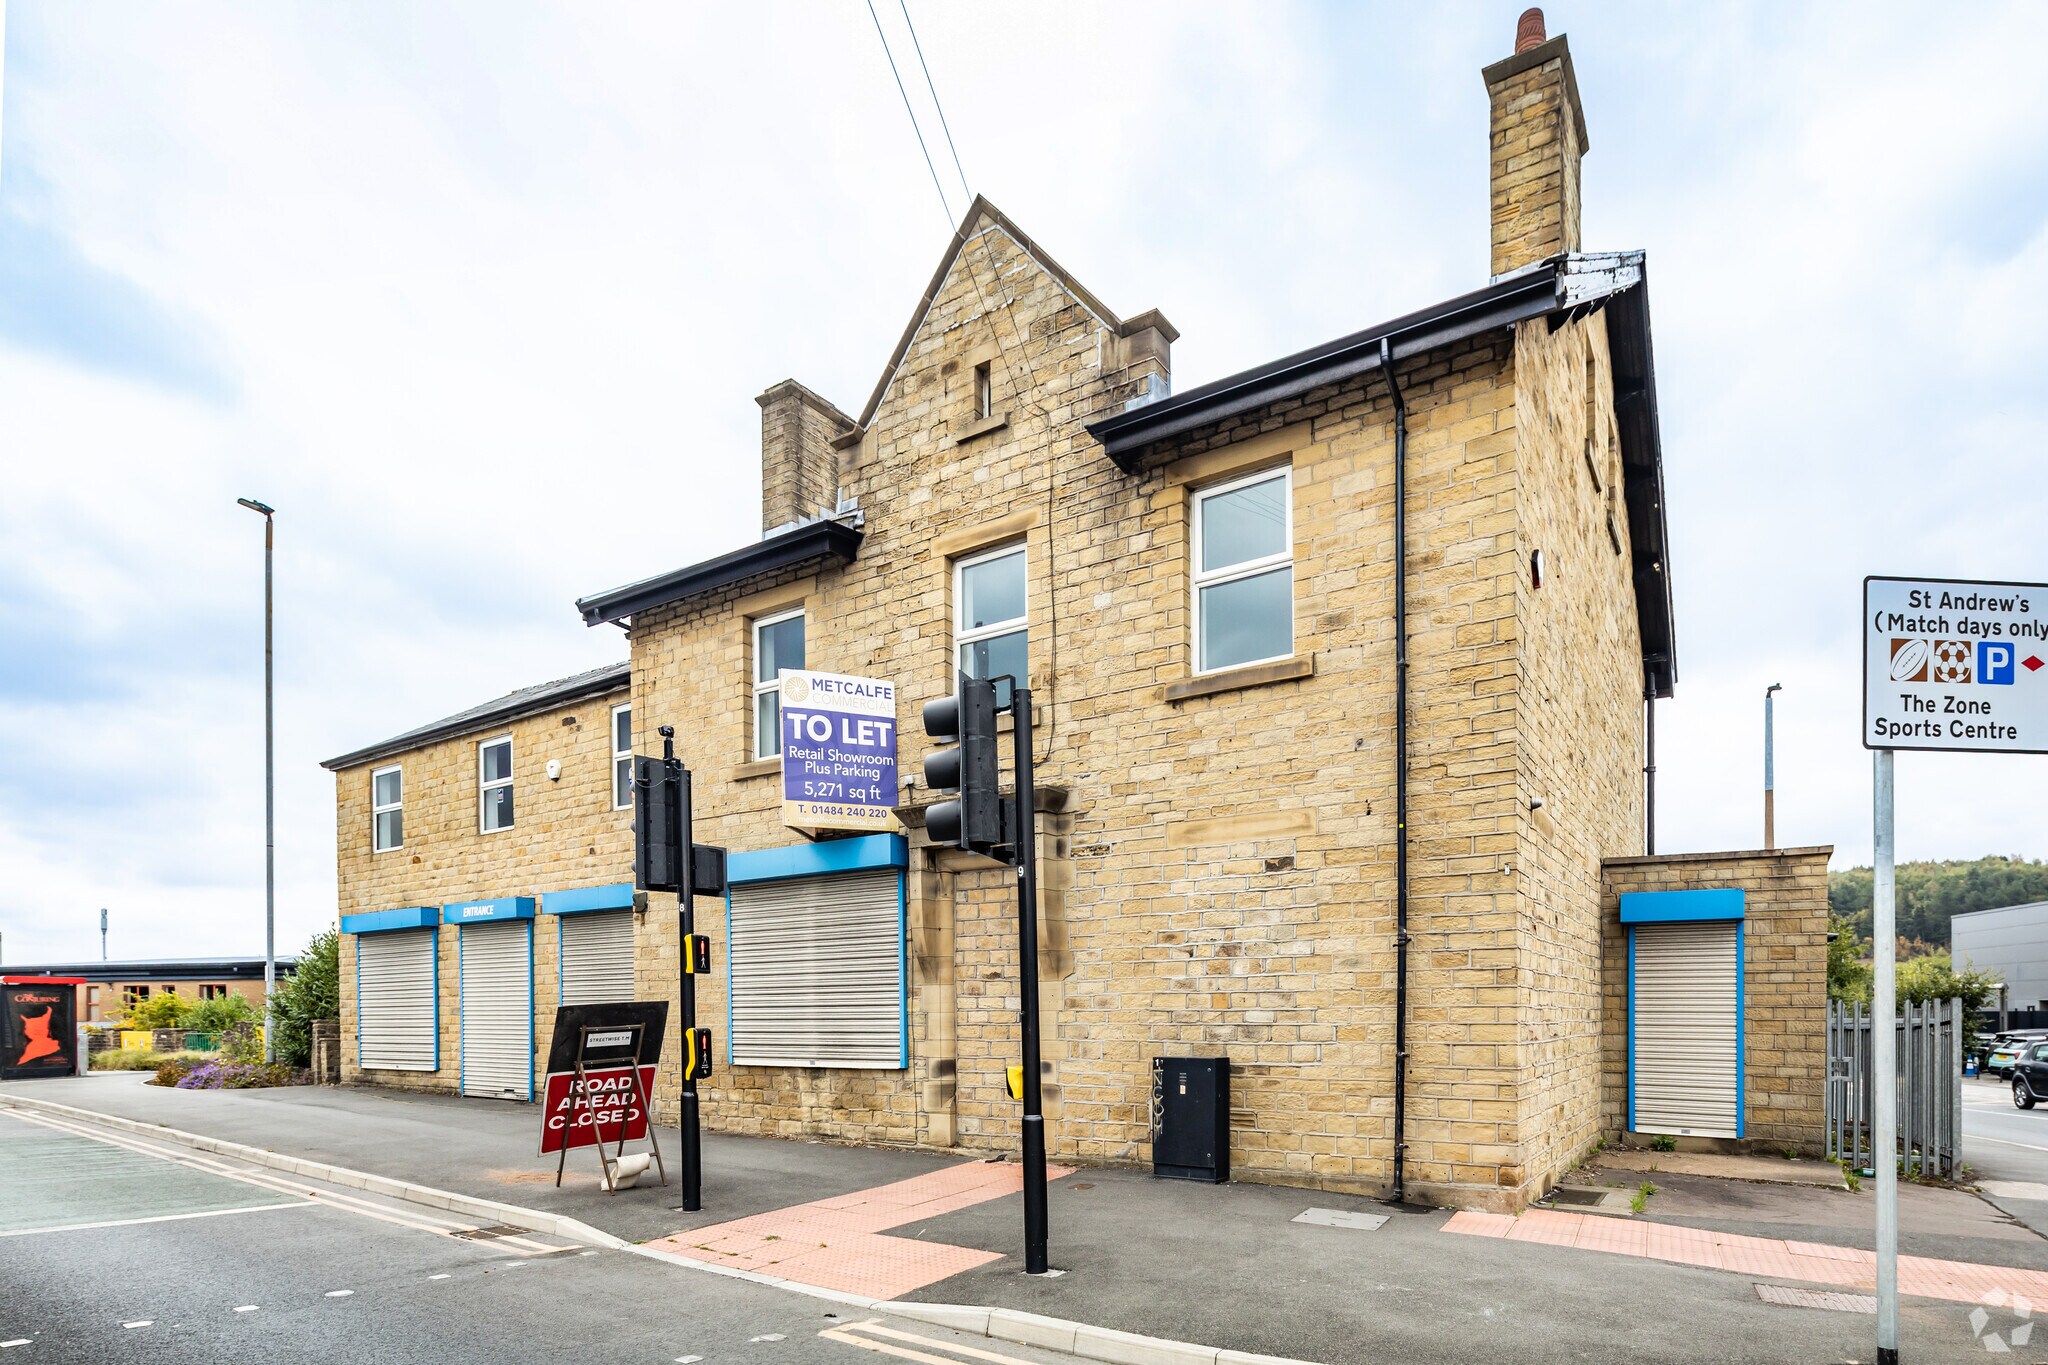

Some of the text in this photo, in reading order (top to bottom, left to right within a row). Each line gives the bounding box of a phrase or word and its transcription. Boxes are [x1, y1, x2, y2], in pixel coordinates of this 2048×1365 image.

[1908, 590, 2030, 613] St Andrew's
[1957, 617, 2001, 638] days
[2009, 619, 2048, 641] only
[1986, 647, 2009, 681] P
[812, 678, 892, 700] METCALFE
[812, 692, 893, 713] COMMERCIAL
[1900, 694, 1991, 714] The Zone
[787, 713, 892, 747] TO LET
[1874, 717, 2017, 739] Sports Centre
[789, 746, 894, 766] Retail Showroom
[805, 761, 880, 781] Plus Parking
[804, 781, 881, 803] 5,271 sq ft
[798, 804, 887, 818] T. 01484 240 220
[1018, 866, 1024, 876] 9
[463, 905, 494, 917] ENTRANCE
[680, 903, 685, 912] 8
[569, 1077, 633, 1093] ROAD
[556, 1092, 637, 1111] AHEAD
